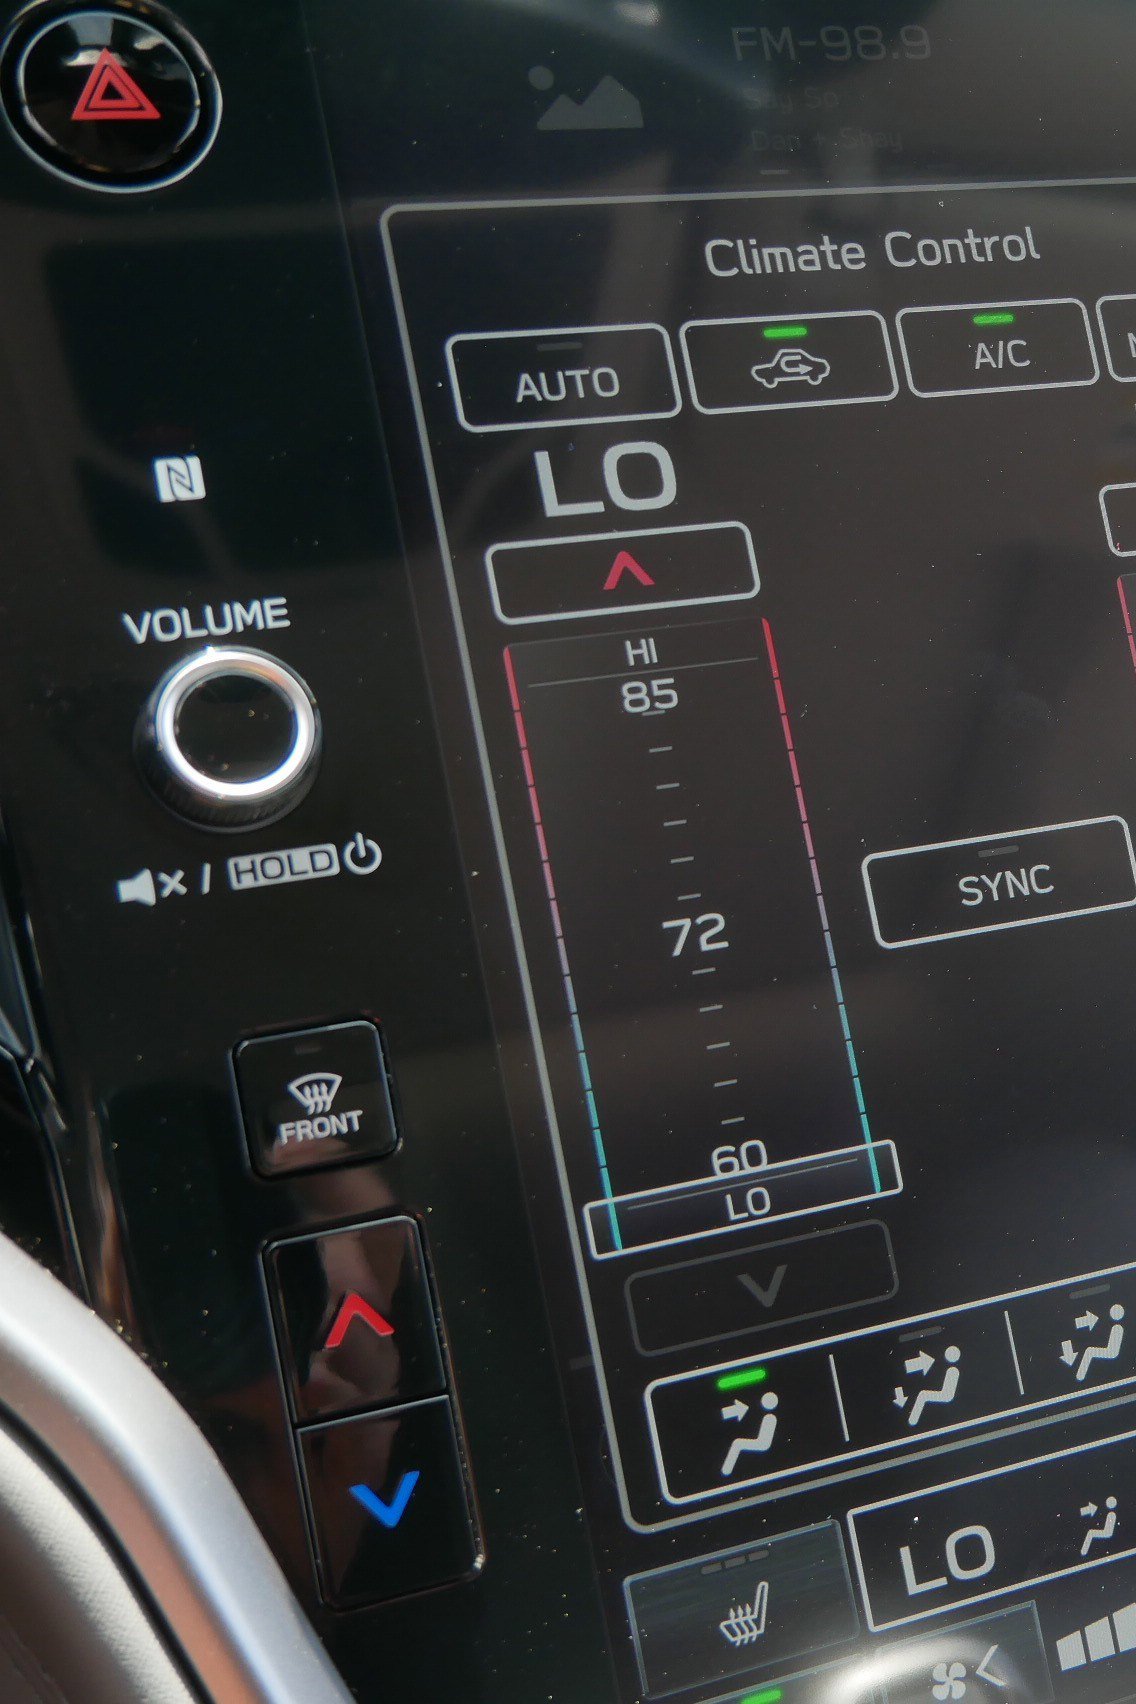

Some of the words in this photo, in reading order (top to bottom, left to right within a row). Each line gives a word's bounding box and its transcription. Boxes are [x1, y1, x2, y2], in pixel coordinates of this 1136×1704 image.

[731, 24, 932, 62] FM-98.9
[704, 234, 866, 277] Climate
[884, 227, 1041, 268] Control
[974, 339, 1031, 369] A/C
[516, 367, 620, 403] AUTO
[534, 441, 677, 517] LO
[122, 597, 291, 644] VOLUME
[624, 638, 658, 666] HI
[620, 677, 679, 713] 85
[233, 849, 334, 886] HOLD
[957, 864, 1055, 907] SYNC
[662, 912, 730, 957] 72
[278, 1110, 363, 1147] FRONT
[711, 1140, 769, 1177] 60
[724, 1186, 772, 1221] LO
[900, 1525, 996, 1596] LO
